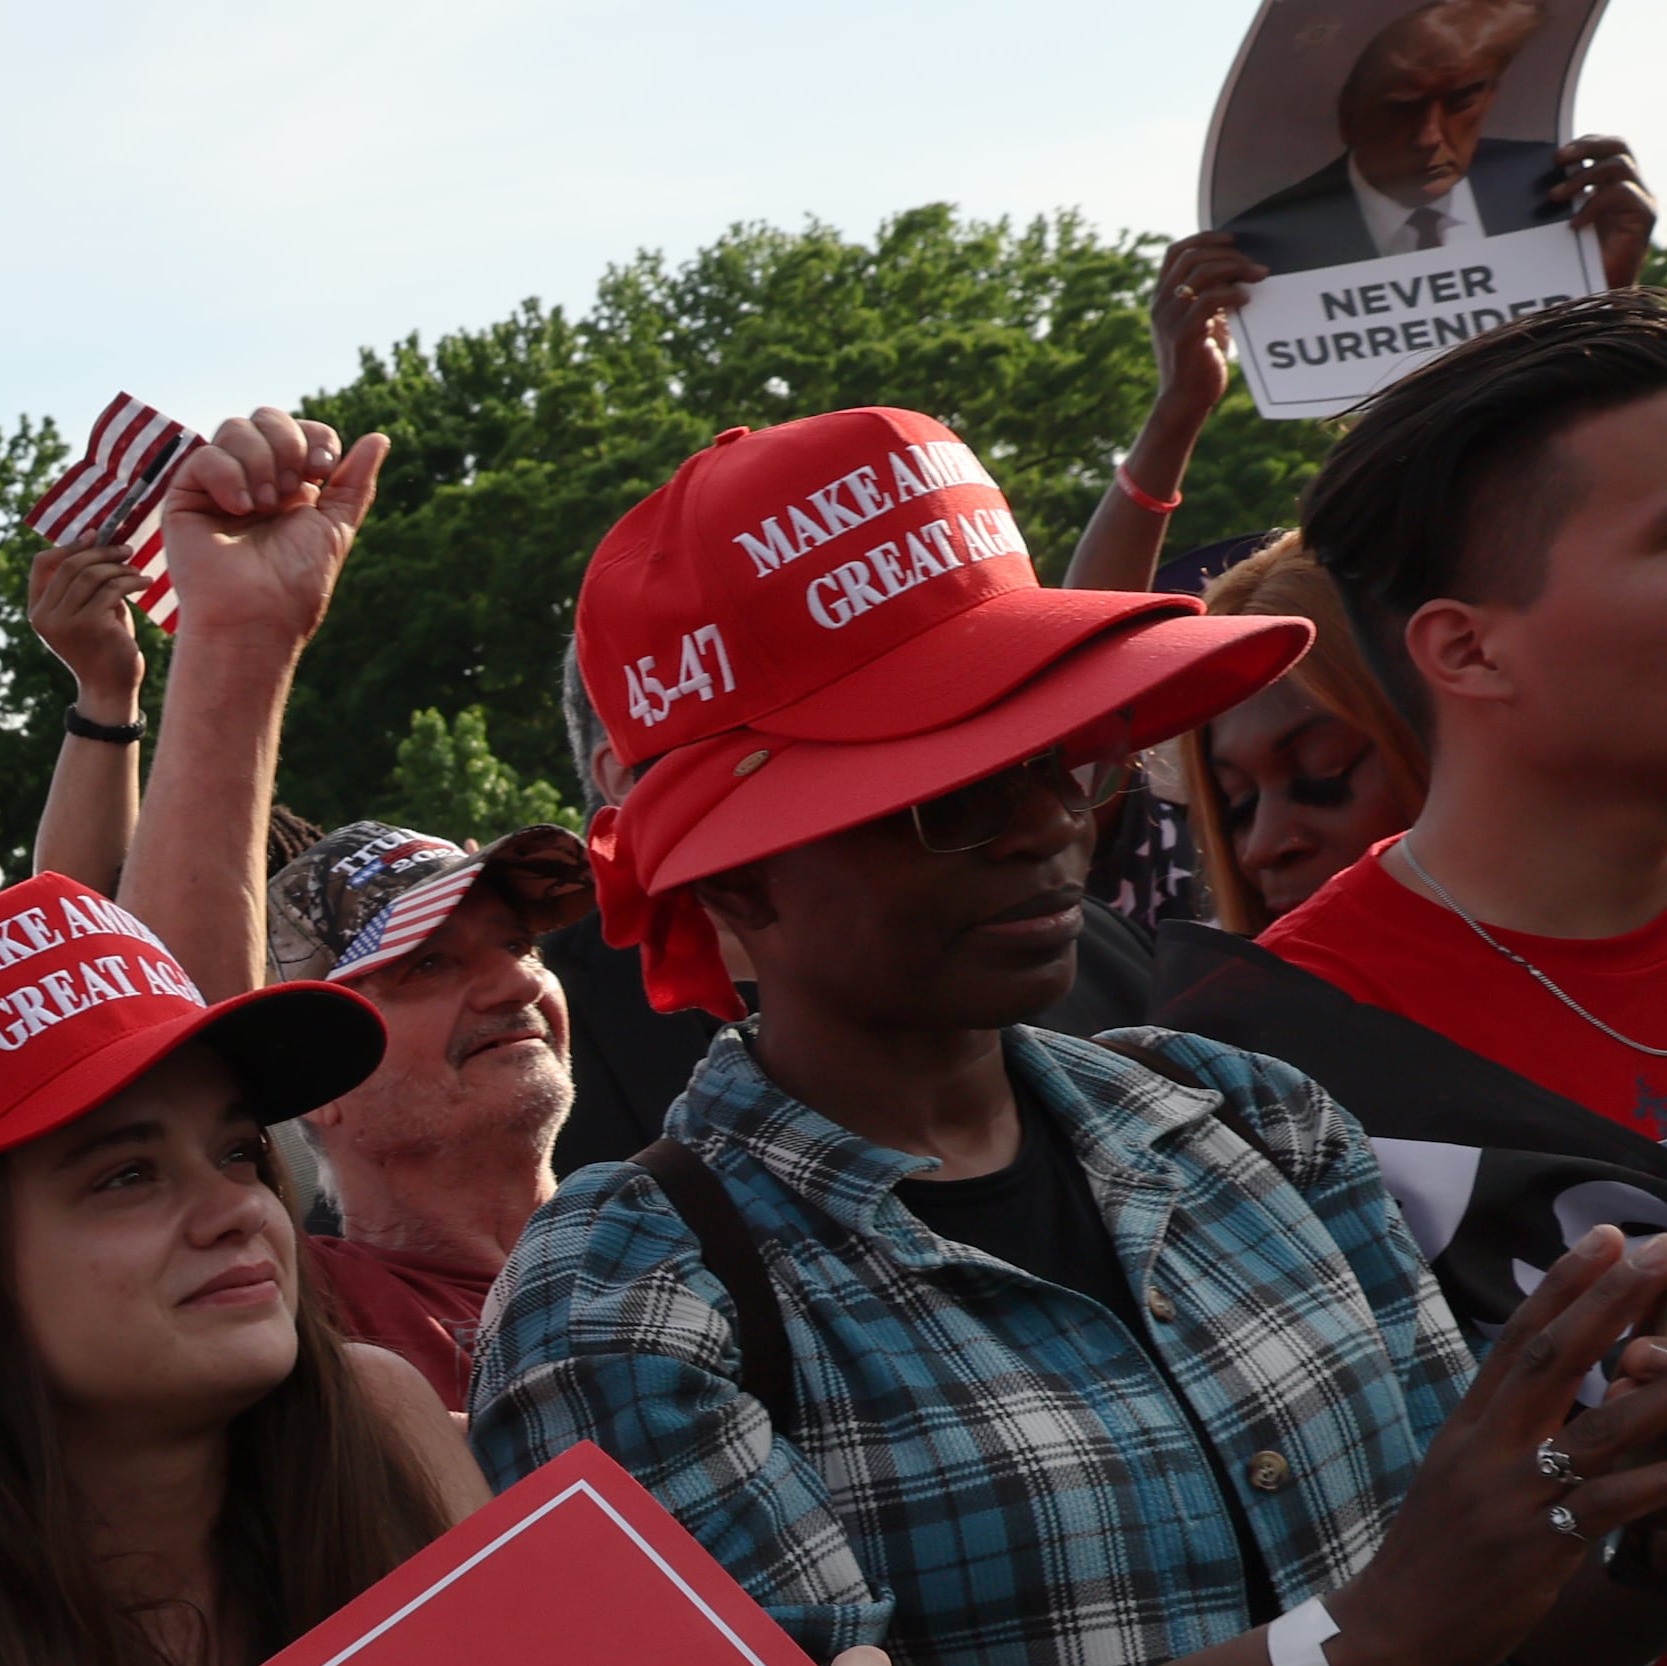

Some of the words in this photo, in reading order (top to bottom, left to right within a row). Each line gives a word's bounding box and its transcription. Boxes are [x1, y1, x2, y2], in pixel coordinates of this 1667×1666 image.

[1266, 294, 1575, 369] SURREND
[1320, 265, 1497, 321] NEVER
[732, 465, 896, 578] MAKE
[806, 519, 964, 629] GREAT
[624, 623, 736, 728] 45-47
